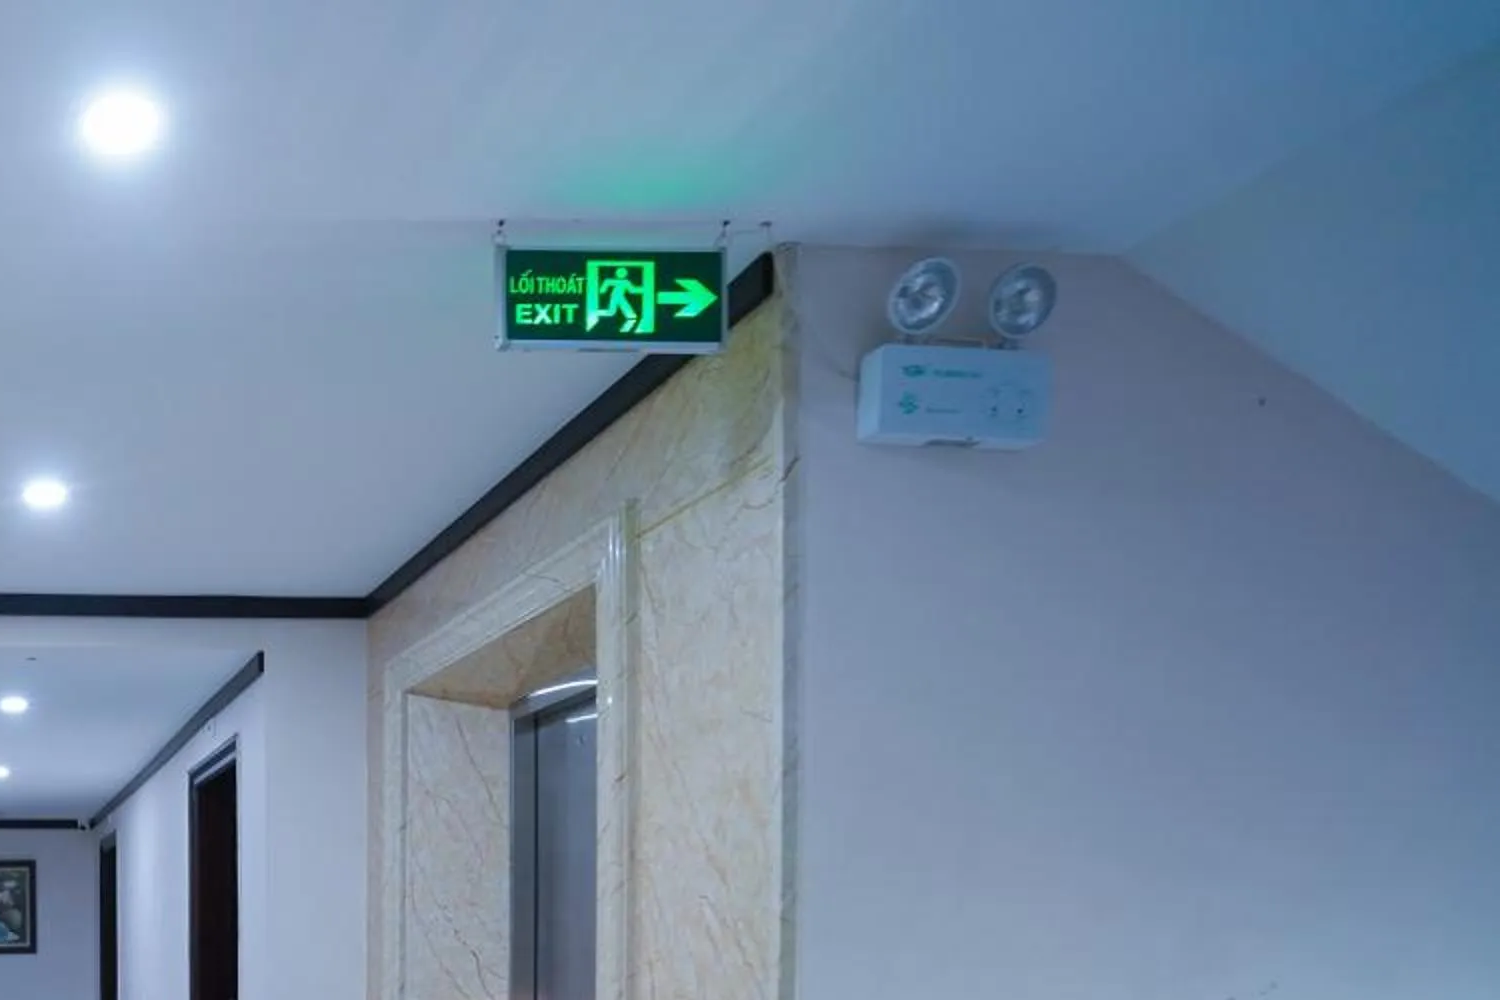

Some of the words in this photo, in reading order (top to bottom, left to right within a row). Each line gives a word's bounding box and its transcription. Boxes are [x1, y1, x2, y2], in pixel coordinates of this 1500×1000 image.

[509, 269, 535, 294] LỐI
[536, 272, 585, 294] THOÁT
[515, 303, 579, 325] EXIT
